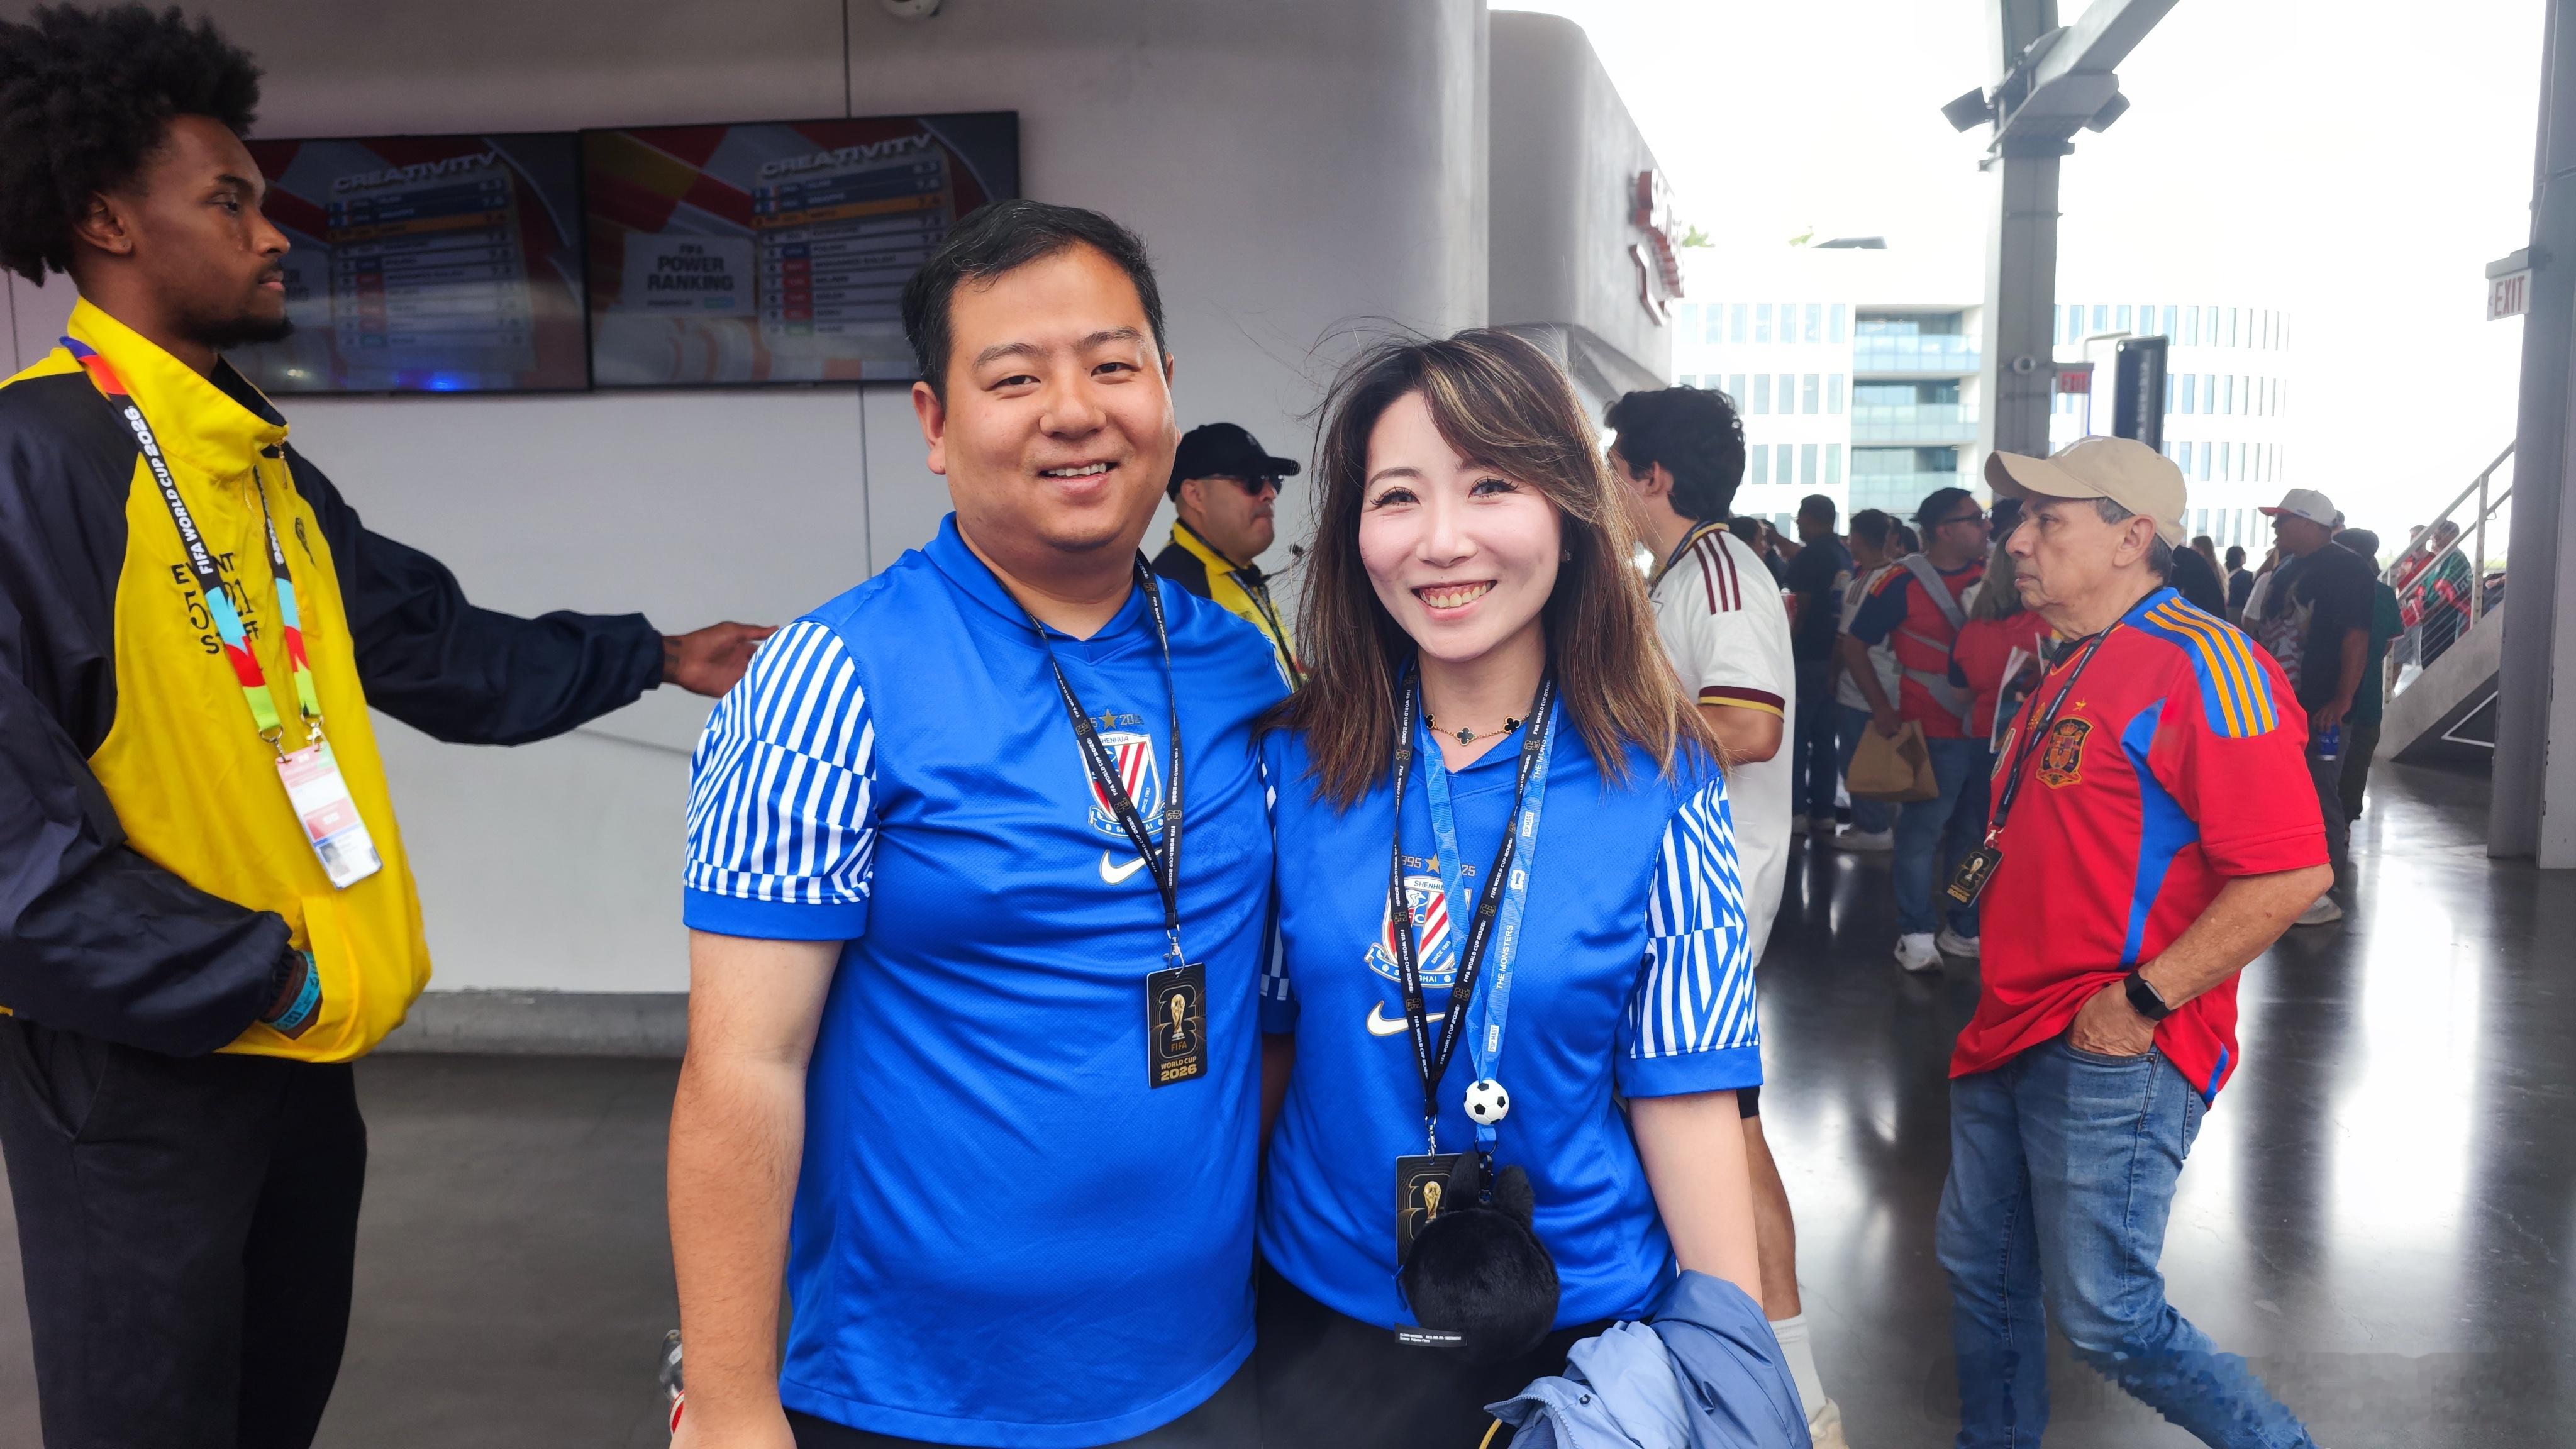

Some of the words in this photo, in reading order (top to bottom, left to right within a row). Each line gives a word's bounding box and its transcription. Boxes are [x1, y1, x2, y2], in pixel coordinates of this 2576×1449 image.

[658, 255, 724, 272] POWER
[647, 274, 734, 291] RANKING
[2494, 275, 2524, 316] EXIT
[124, 407, 160, 457] 2026
[152, 458, 172, 487] CUP
[166, 489, 197, 541] WORLD
[191, 542, 214, 575] FIFA
[1536, 706, 1545, 724] WORLD
[1100, 766, 1113, 784] WORLD
[1533, 762, 1542, 779] THE
[1109, 784, 1118, 796] FIFA
[1401, 855, 1422, 869] 995
[1414, 880, 1444, 889] SHENHU
[1494, 867, 1502, 886] WORLD
[1401, 941, 1409, 962] WORLD
[1431, 950, 1443, 964] SINCE
[1499, 925, 1513, 973] MONSTERS
[1468, 951, 1477, 970] WORLD
[1496, 972, 1505, 990] THE
[1170, 1041, 1187, 1052] FIFA
[1443, 1035, 1452, 1053] WORLD
[1161, 1059, 1184, 1070] WORLD
[1184, 1055, 1197, 1065] CUP
[1160, 1064, 1197, 1082] 2026
